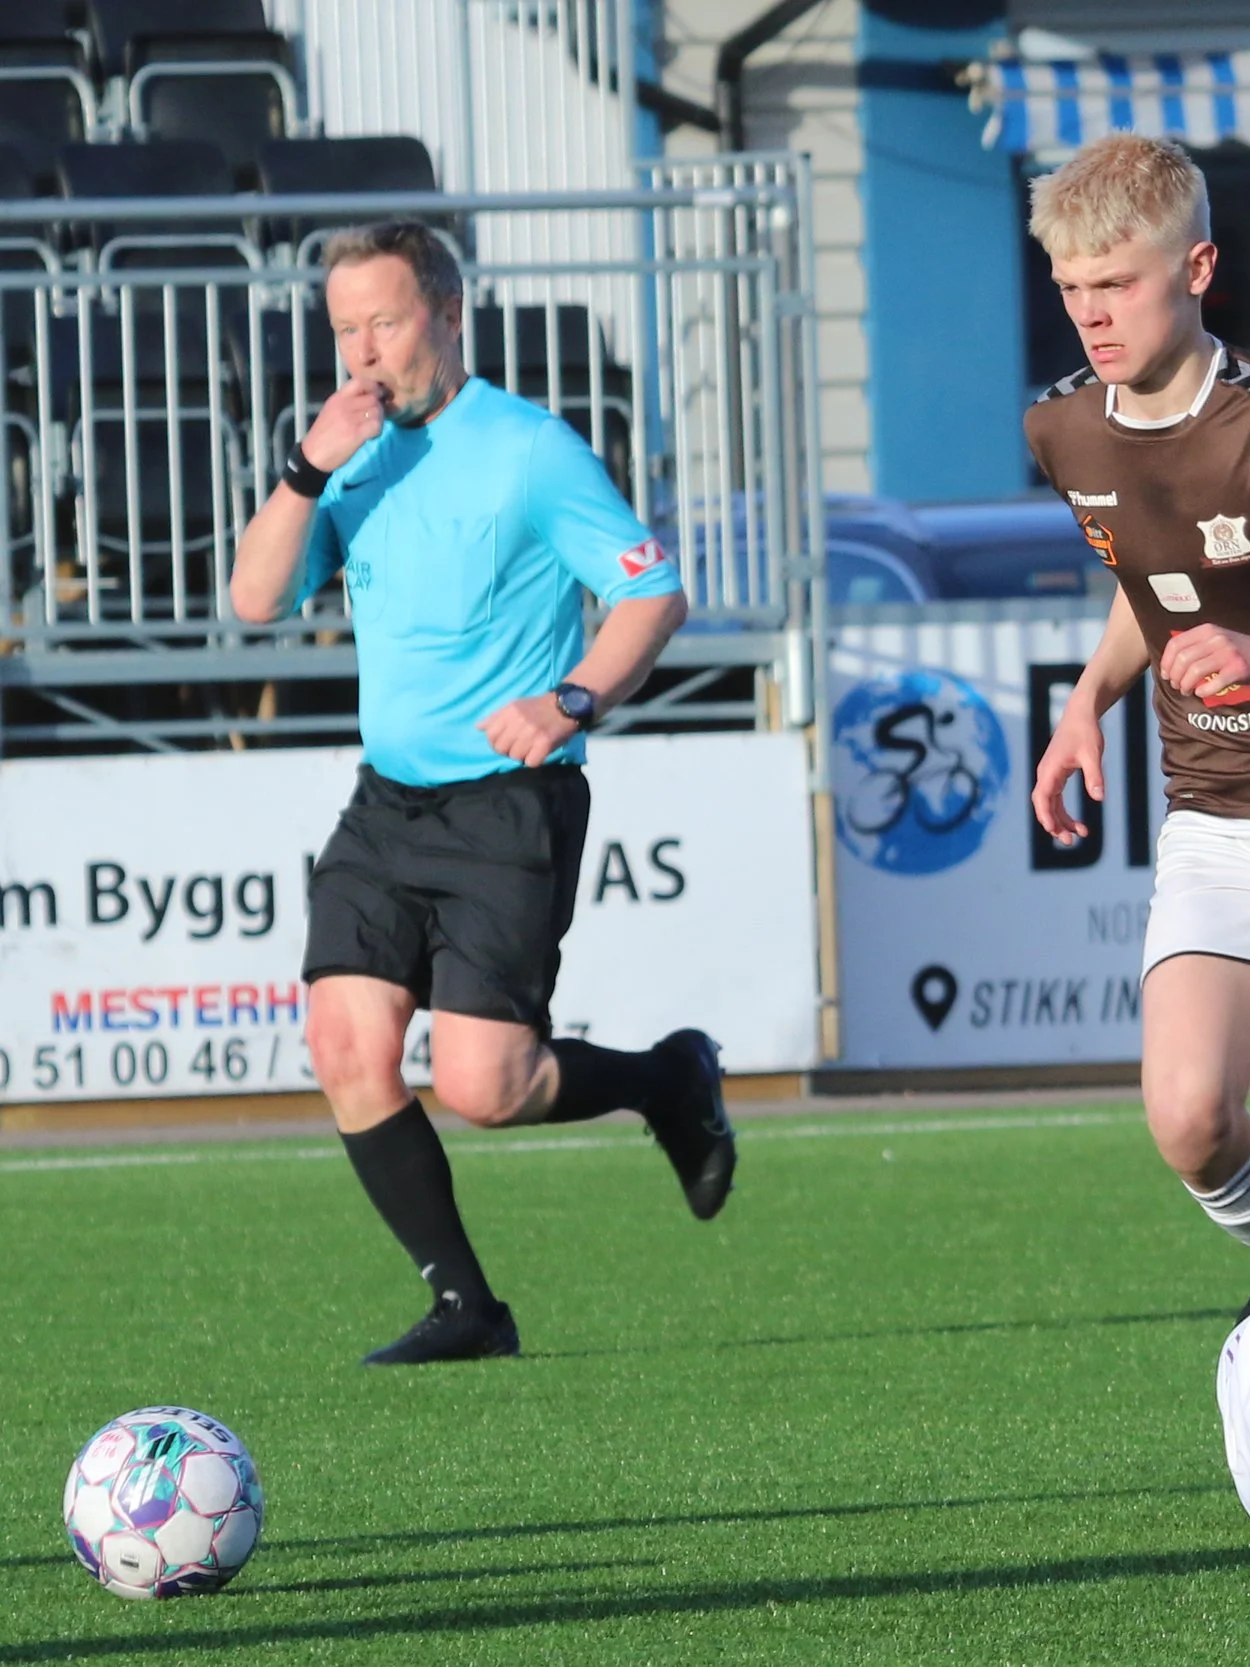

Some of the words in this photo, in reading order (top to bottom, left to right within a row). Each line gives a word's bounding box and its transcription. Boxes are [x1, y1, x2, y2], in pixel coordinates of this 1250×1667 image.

[1078, 490, 1118, 507] hummel
[85, 860, 277, 942] Bygg
[593, 838, 686, 904] AS
[51, 981, 312, 1034] MESTERH
[969, 975, 1088, 1029] STIKK
[32, 1043, 85, 1092] 51
[110, 1039, 169, 1087] 00
[189, 1036, 249, 1084] 46
